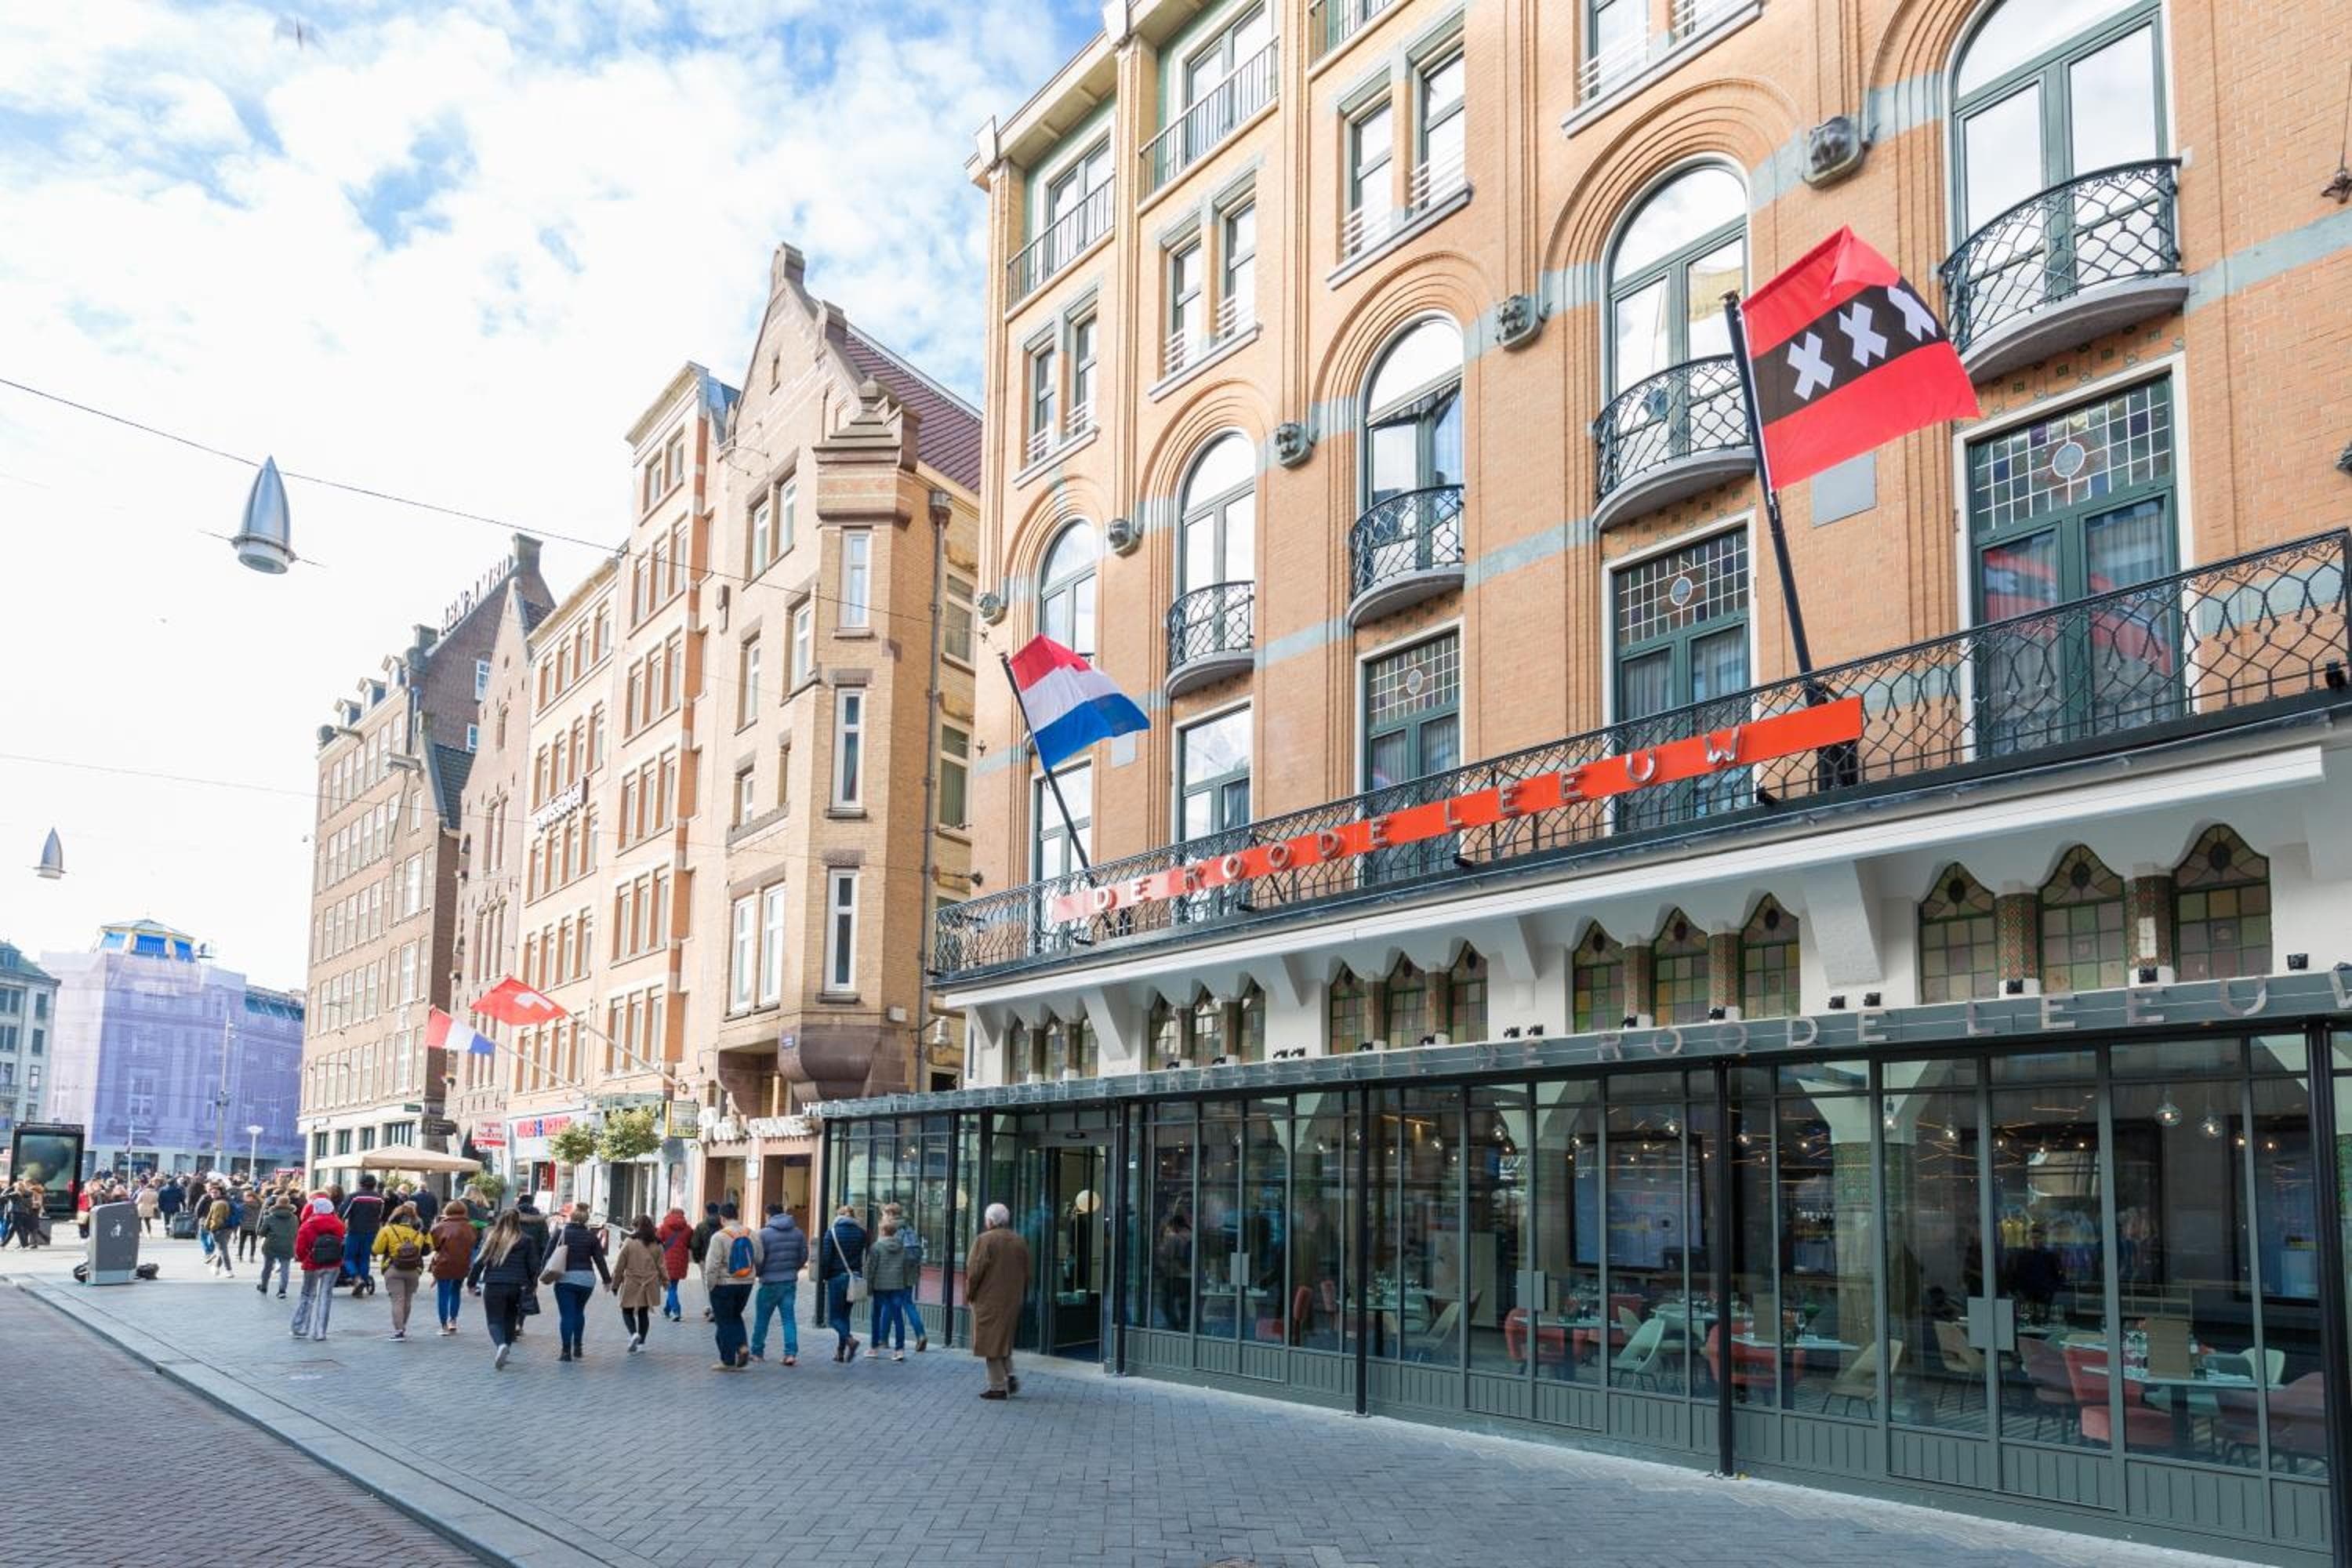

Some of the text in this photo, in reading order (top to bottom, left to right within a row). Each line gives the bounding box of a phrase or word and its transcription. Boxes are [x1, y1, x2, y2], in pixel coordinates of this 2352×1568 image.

[1094, 726, 1741, 910] DE ROODE LEEUW
[1474, 1038, 1544, 1069] DE
[1597, 1008, 1887, 1062] ROODE
